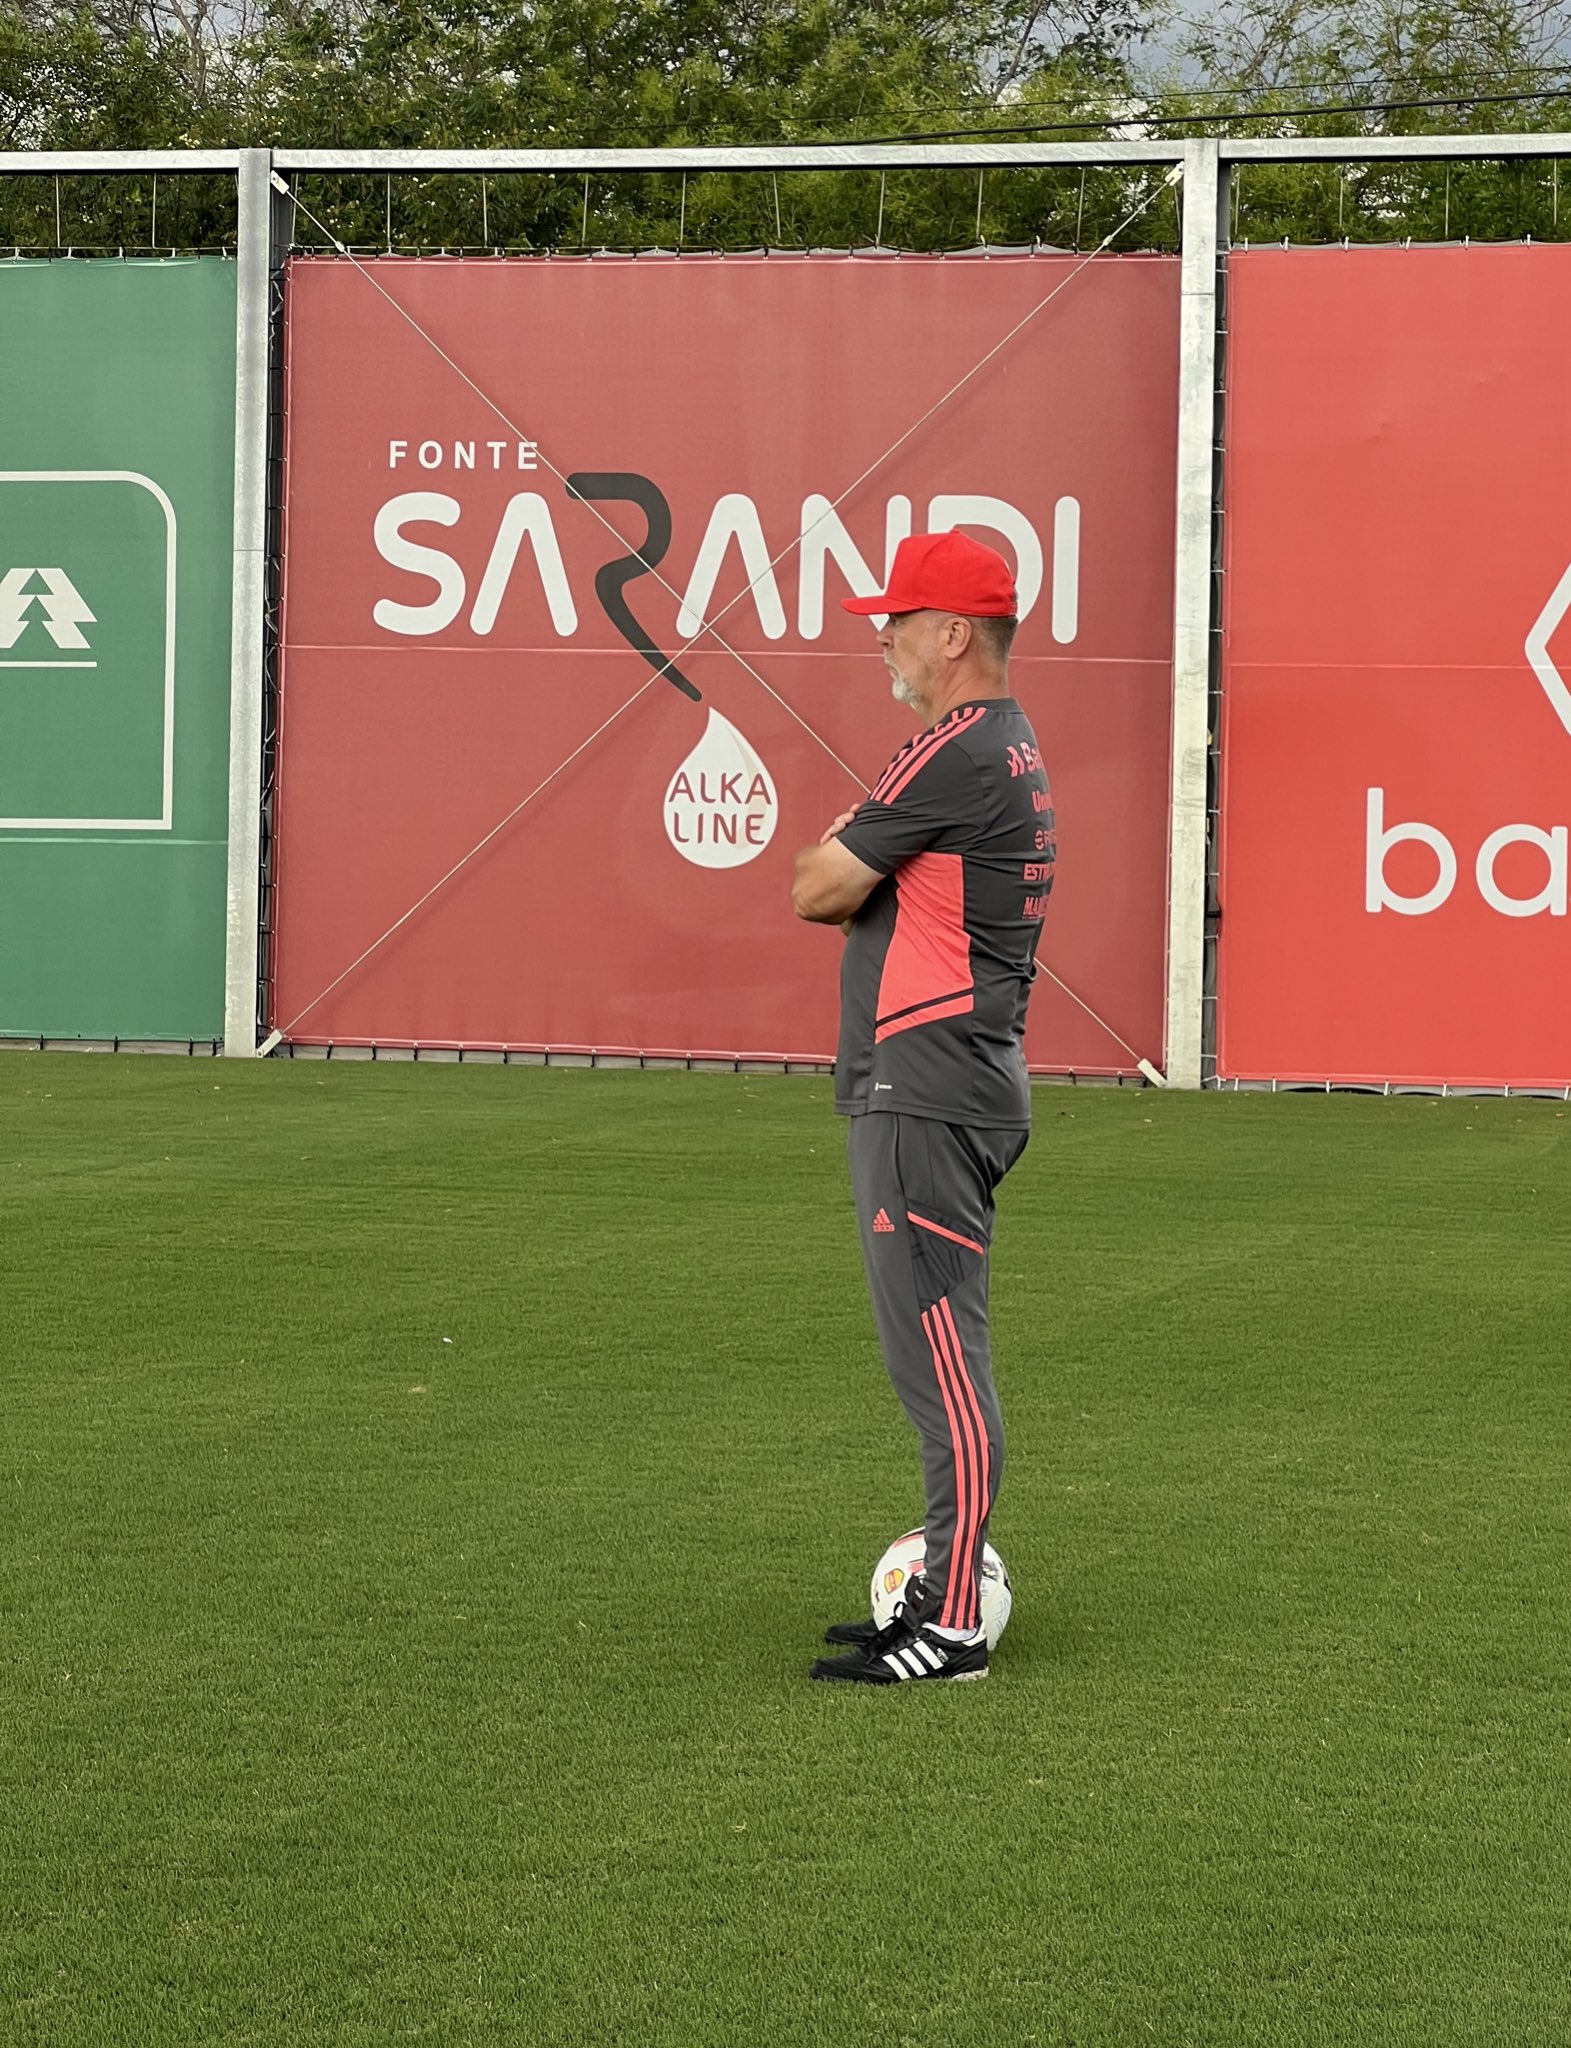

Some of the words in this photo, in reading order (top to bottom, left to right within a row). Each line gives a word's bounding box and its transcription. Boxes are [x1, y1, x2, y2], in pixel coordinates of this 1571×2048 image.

[389, 440, 538, 470] FONTE
[373, 472, 1081, 702] SARANDI
[668, 771, 772, 805] ALKA
[674, 811, 765, 845] LINE
[1365, 787, 1569, 918] ba
